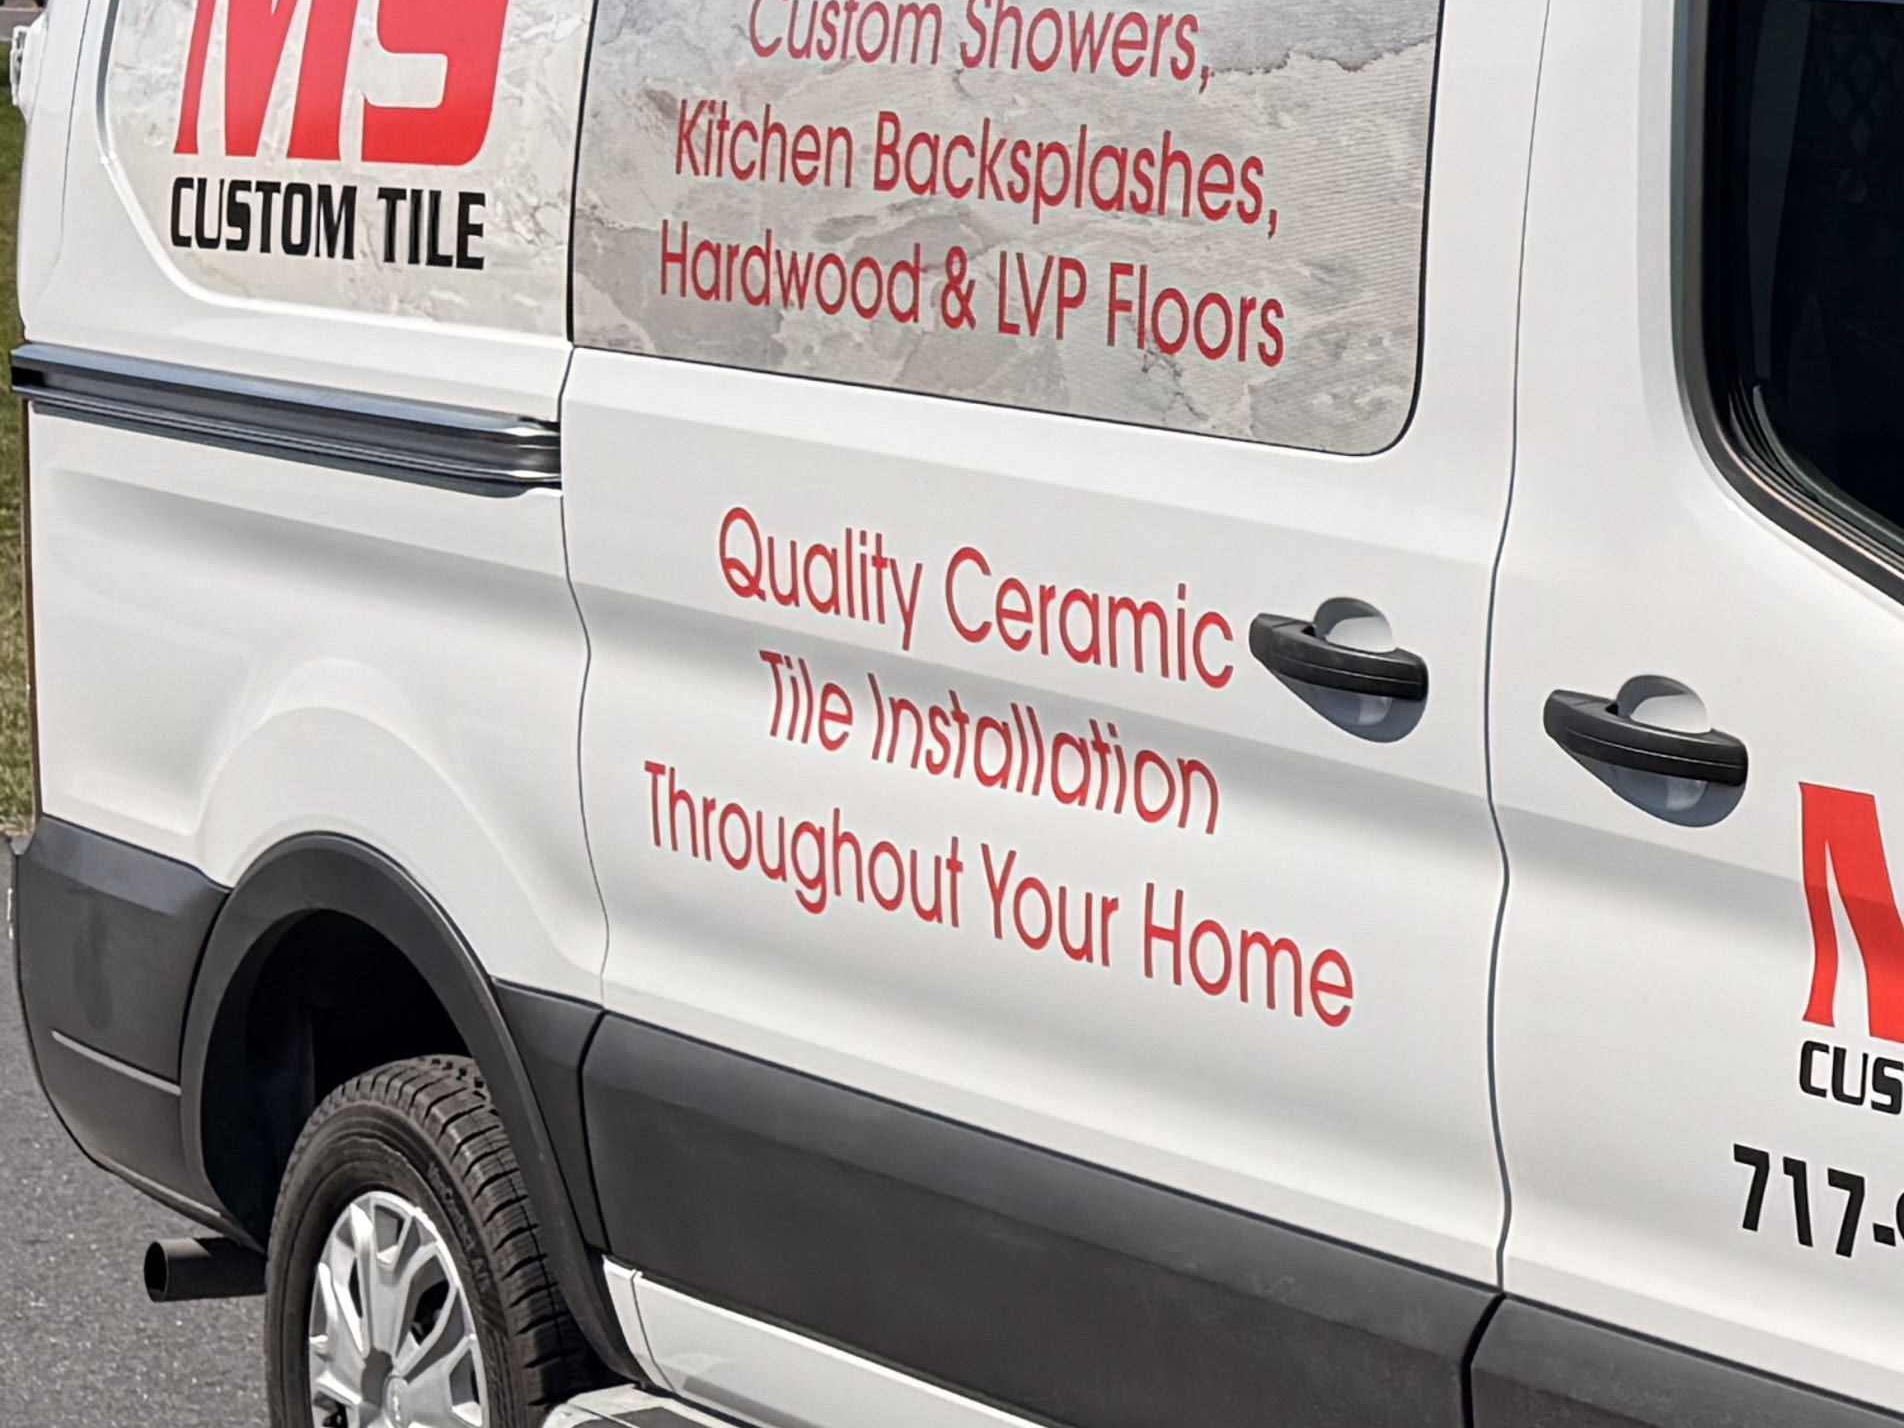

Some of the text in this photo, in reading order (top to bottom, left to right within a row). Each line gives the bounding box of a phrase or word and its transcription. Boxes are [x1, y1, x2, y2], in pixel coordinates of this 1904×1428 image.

[170, 177, 487, 271] CUSTOM TILE
[675, 99, 1279, 238] Kitchen Backsplashes,
[660, 219, 1285, 369] Hardwood & LVP Floors
[718, 506, 1235, 690] Quality Ceramic
[759, 650, 1220, 835] Tile Installation
[644, 760, 1356, 1028] Throughout Your Home
